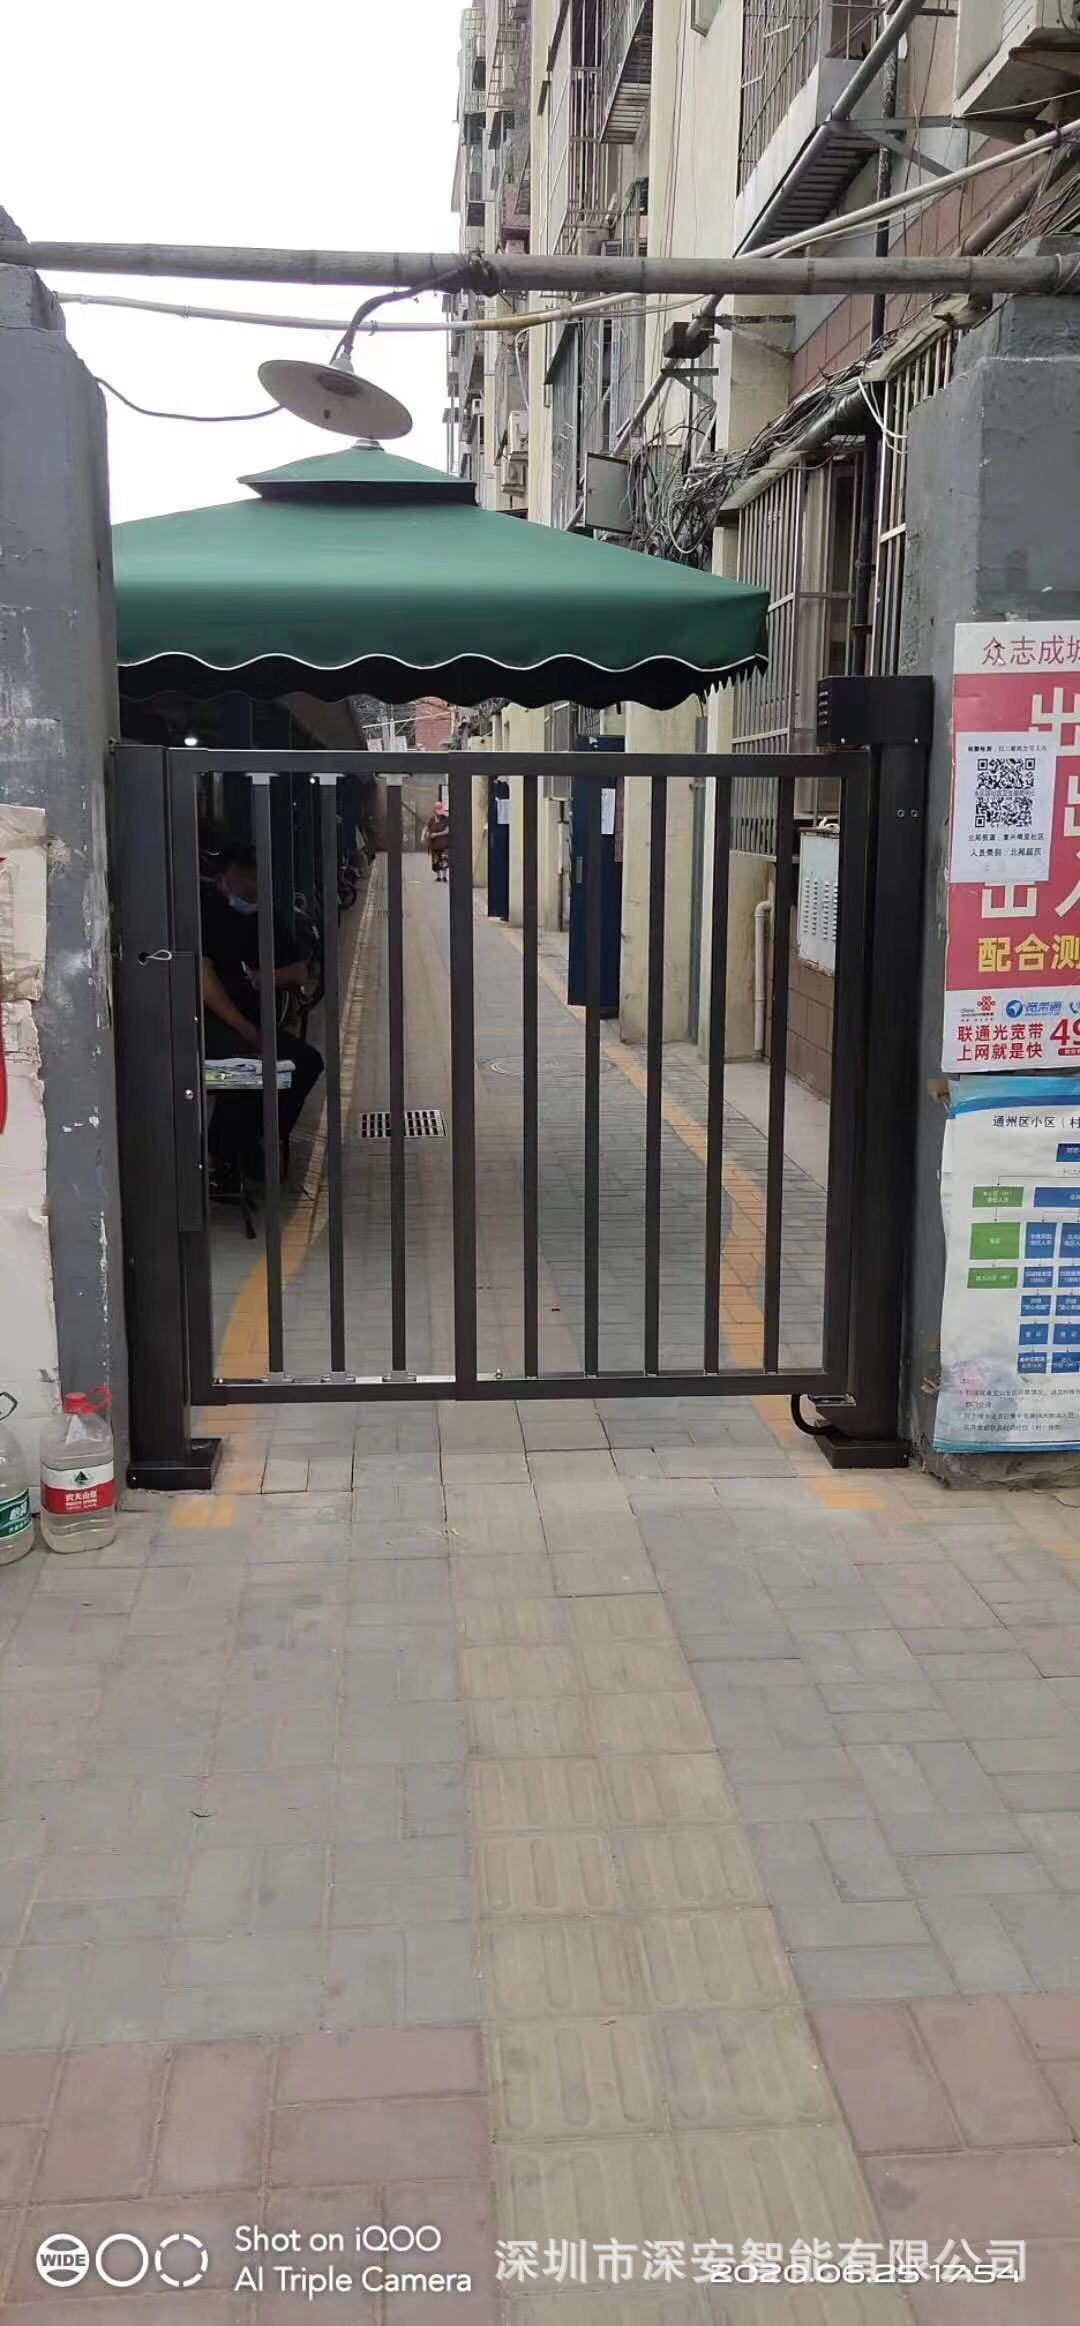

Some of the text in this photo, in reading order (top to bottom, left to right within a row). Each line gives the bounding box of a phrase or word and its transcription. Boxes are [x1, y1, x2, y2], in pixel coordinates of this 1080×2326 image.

[957, 1023, 1044, 1042] 联通光宽带
[957, 1042, 1043, 1061] 上网就是快
